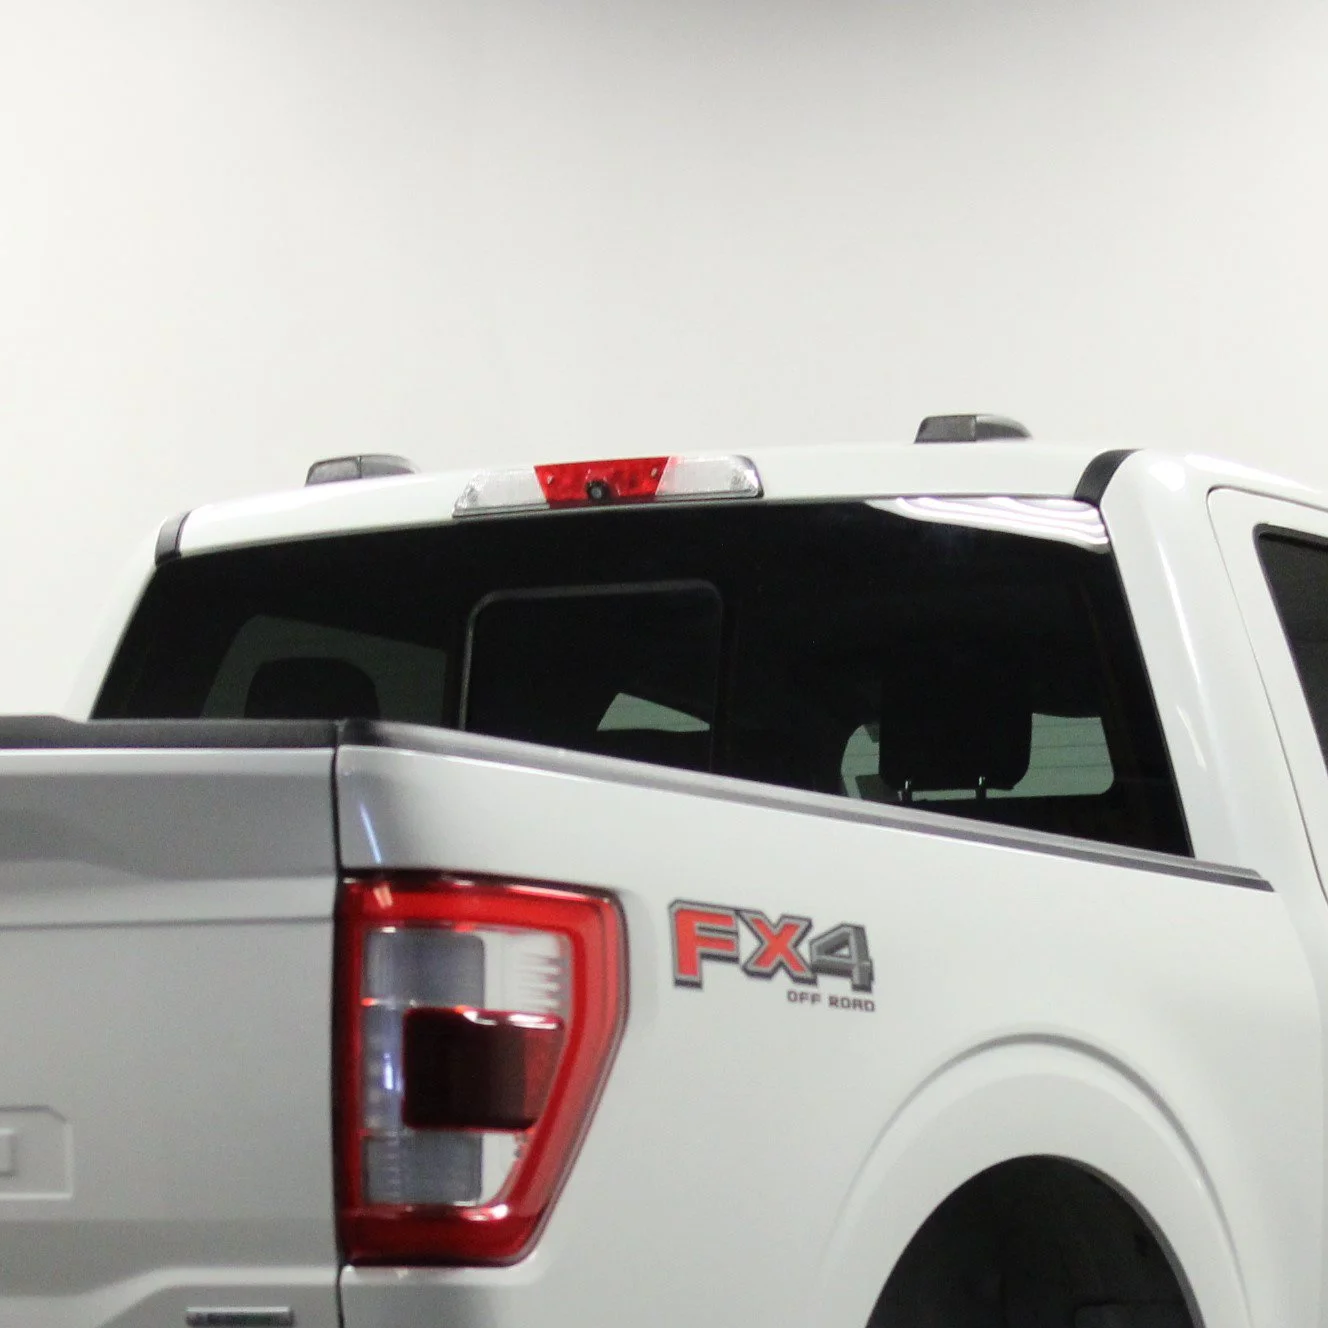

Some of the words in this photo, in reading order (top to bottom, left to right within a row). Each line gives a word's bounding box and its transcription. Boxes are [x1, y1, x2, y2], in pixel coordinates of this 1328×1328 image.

[668, 898, 875, 994] FX4
[787, 990, 822, 1006] OFF
[828, 995, 876, 1013] ROAD
